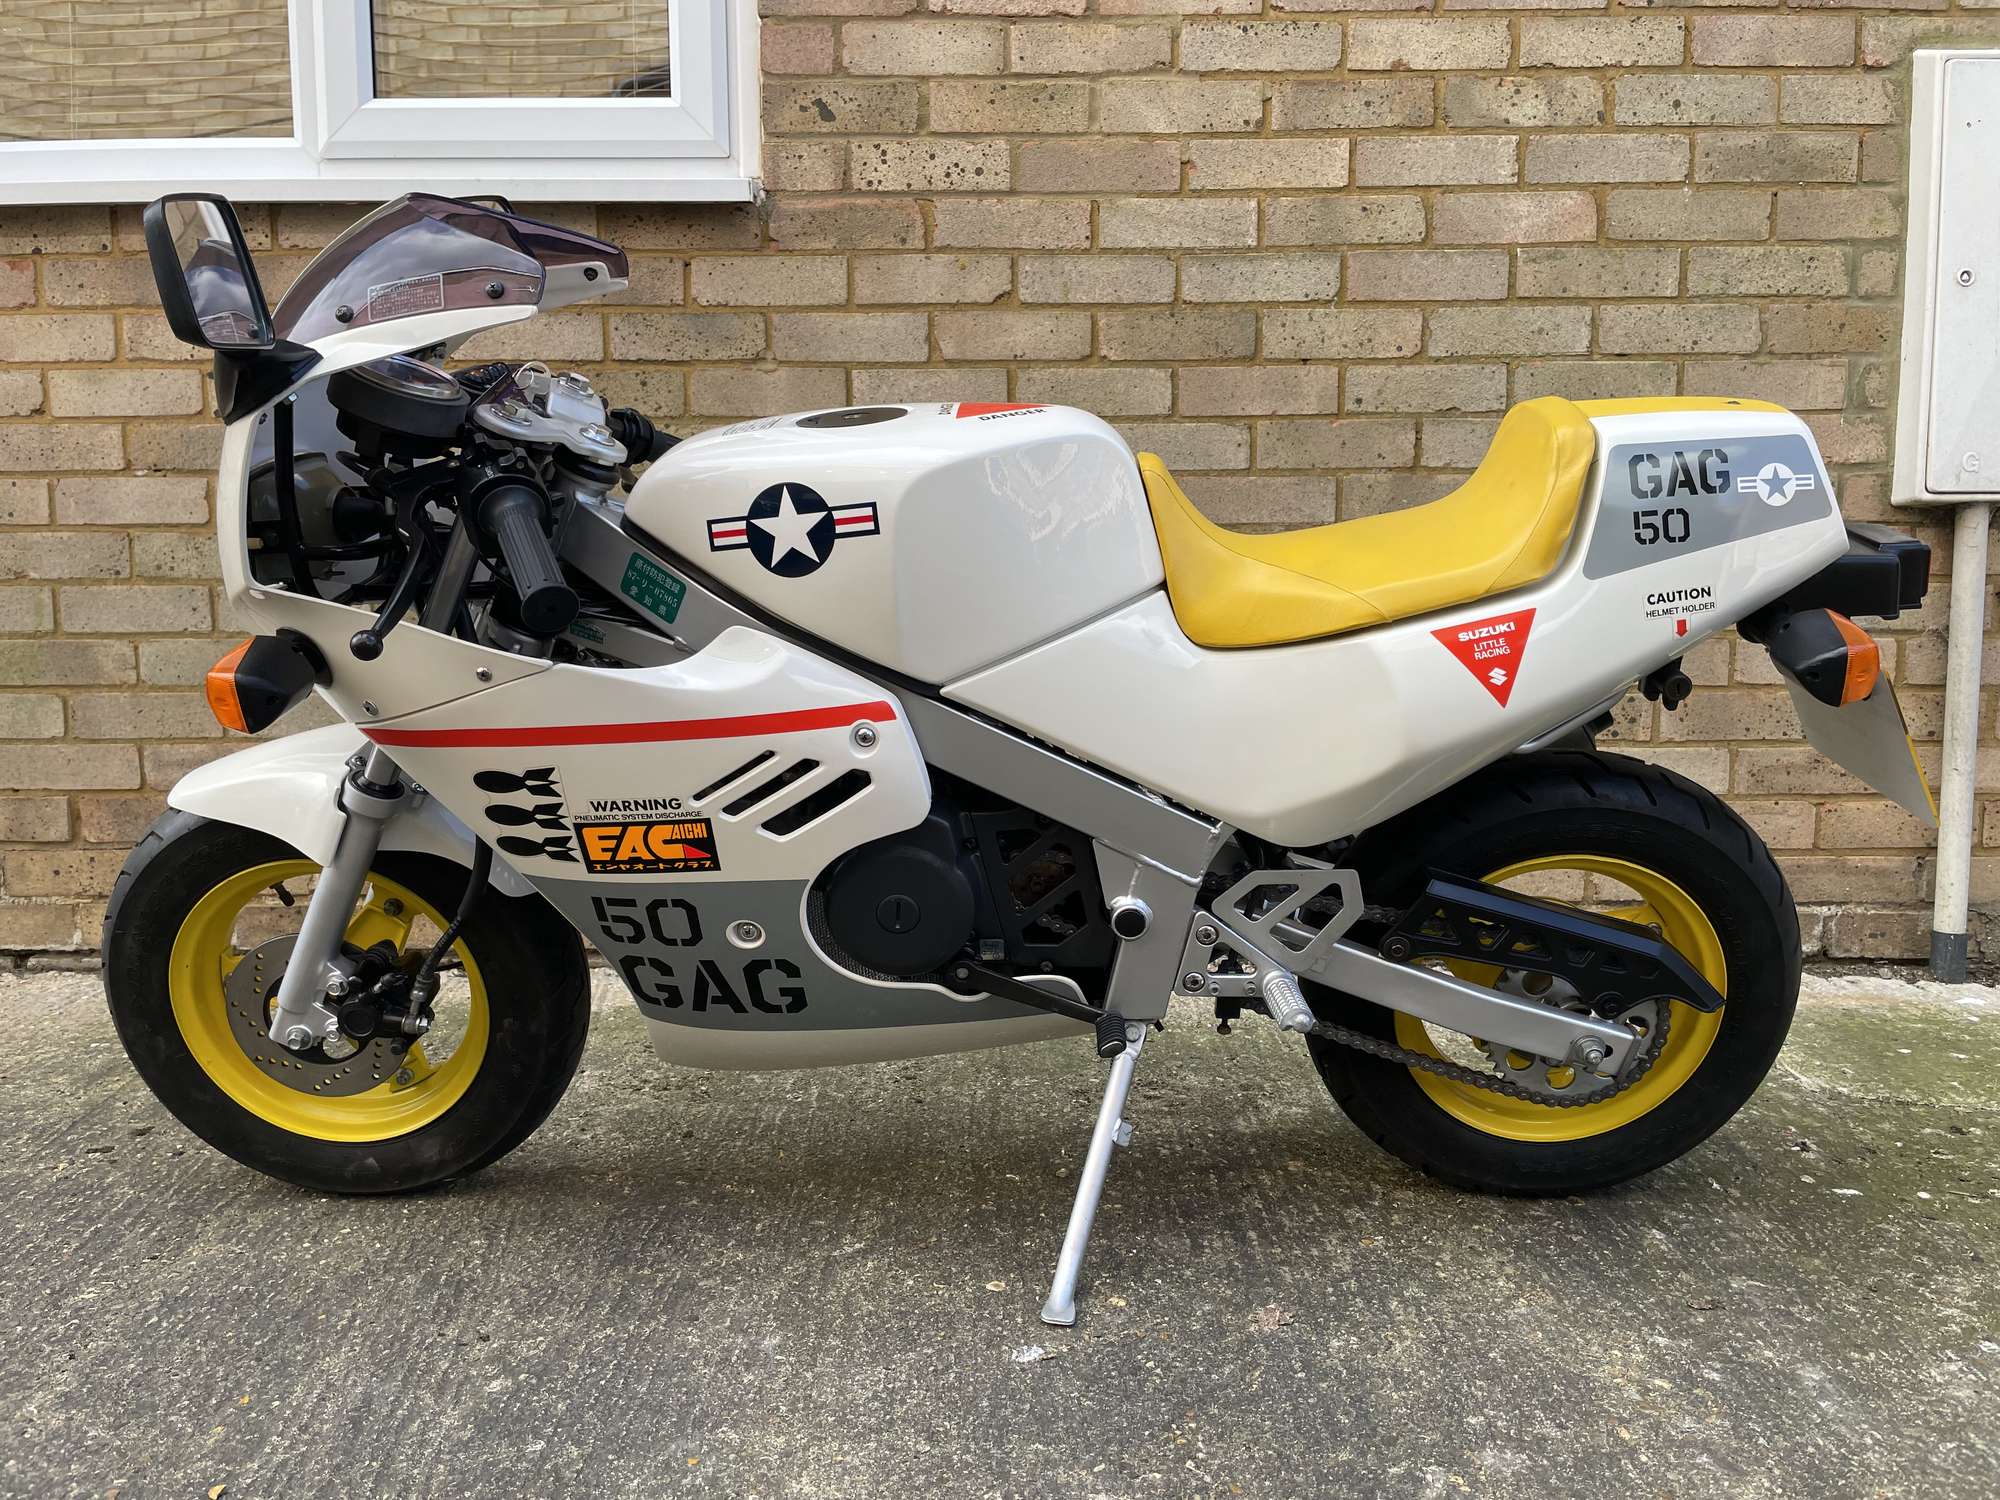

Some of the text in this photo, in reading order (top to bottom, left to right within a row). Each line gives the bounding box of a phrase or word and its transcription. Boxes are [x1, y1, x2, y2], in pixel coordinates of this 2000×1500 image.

[979, 408, 1047, 421] DANGER
[1962, 451, 1979, 473] G
[1628, 448, 1731, 500] GAG
[1633, 508, 1691, 545] 50
[1646, 586, 1712, 606] CAUTION
[1645, 602, 1716, 618] HELMET HOLDER
[1457, 621, 1516, 642] SUZUKI
[1473, 637, 1507, 652] LITTLE
[1474, 645, 1511, 661] RACING
[589, 798, 682, 813] WARNING
[574, 810, 703, 822] PNEUMATIC SYSTEM DISCHARGE
[671, 822, 708, 840] AICHI
[582, 824, 686, 861] EAC
[591, 896, 704, 947] 50
[618, 954, 809, 1014] GAG
